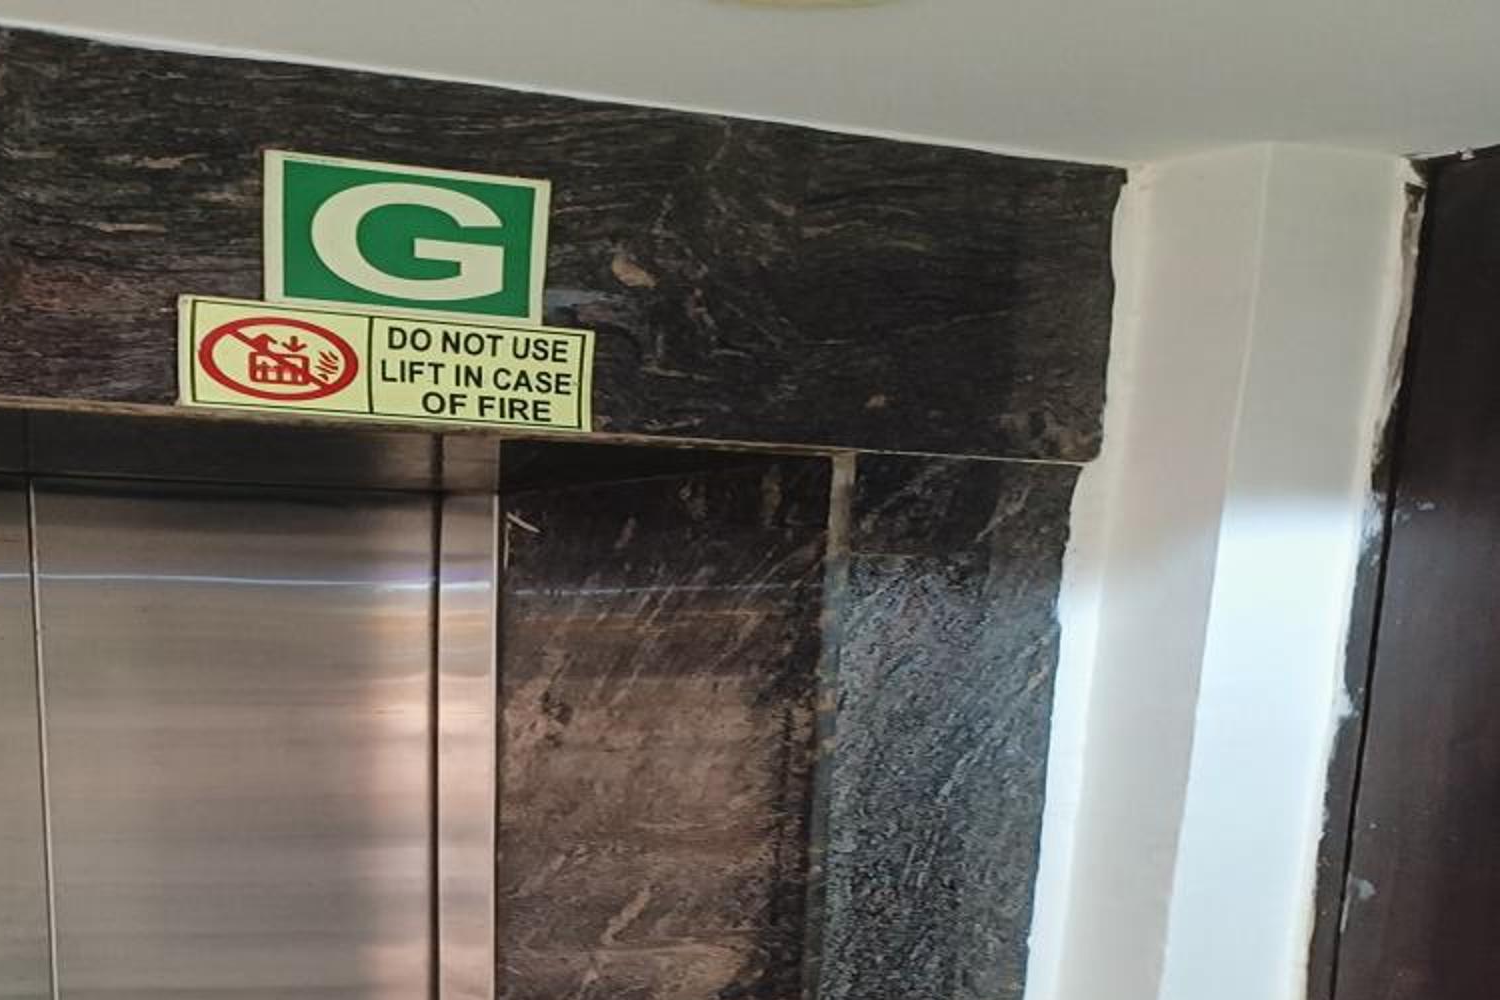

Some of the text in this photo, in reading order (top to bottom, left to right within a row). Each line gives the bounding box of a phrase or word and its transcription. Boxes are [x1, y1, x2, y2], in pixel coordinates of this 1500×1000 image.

[311, 182, 505, 301] G
[388, 326, 569, 363] DO NOT USE
[381, 360, 572, 395] LIFT IN CASE
[422, 391, 552, 421] OF FIRE
